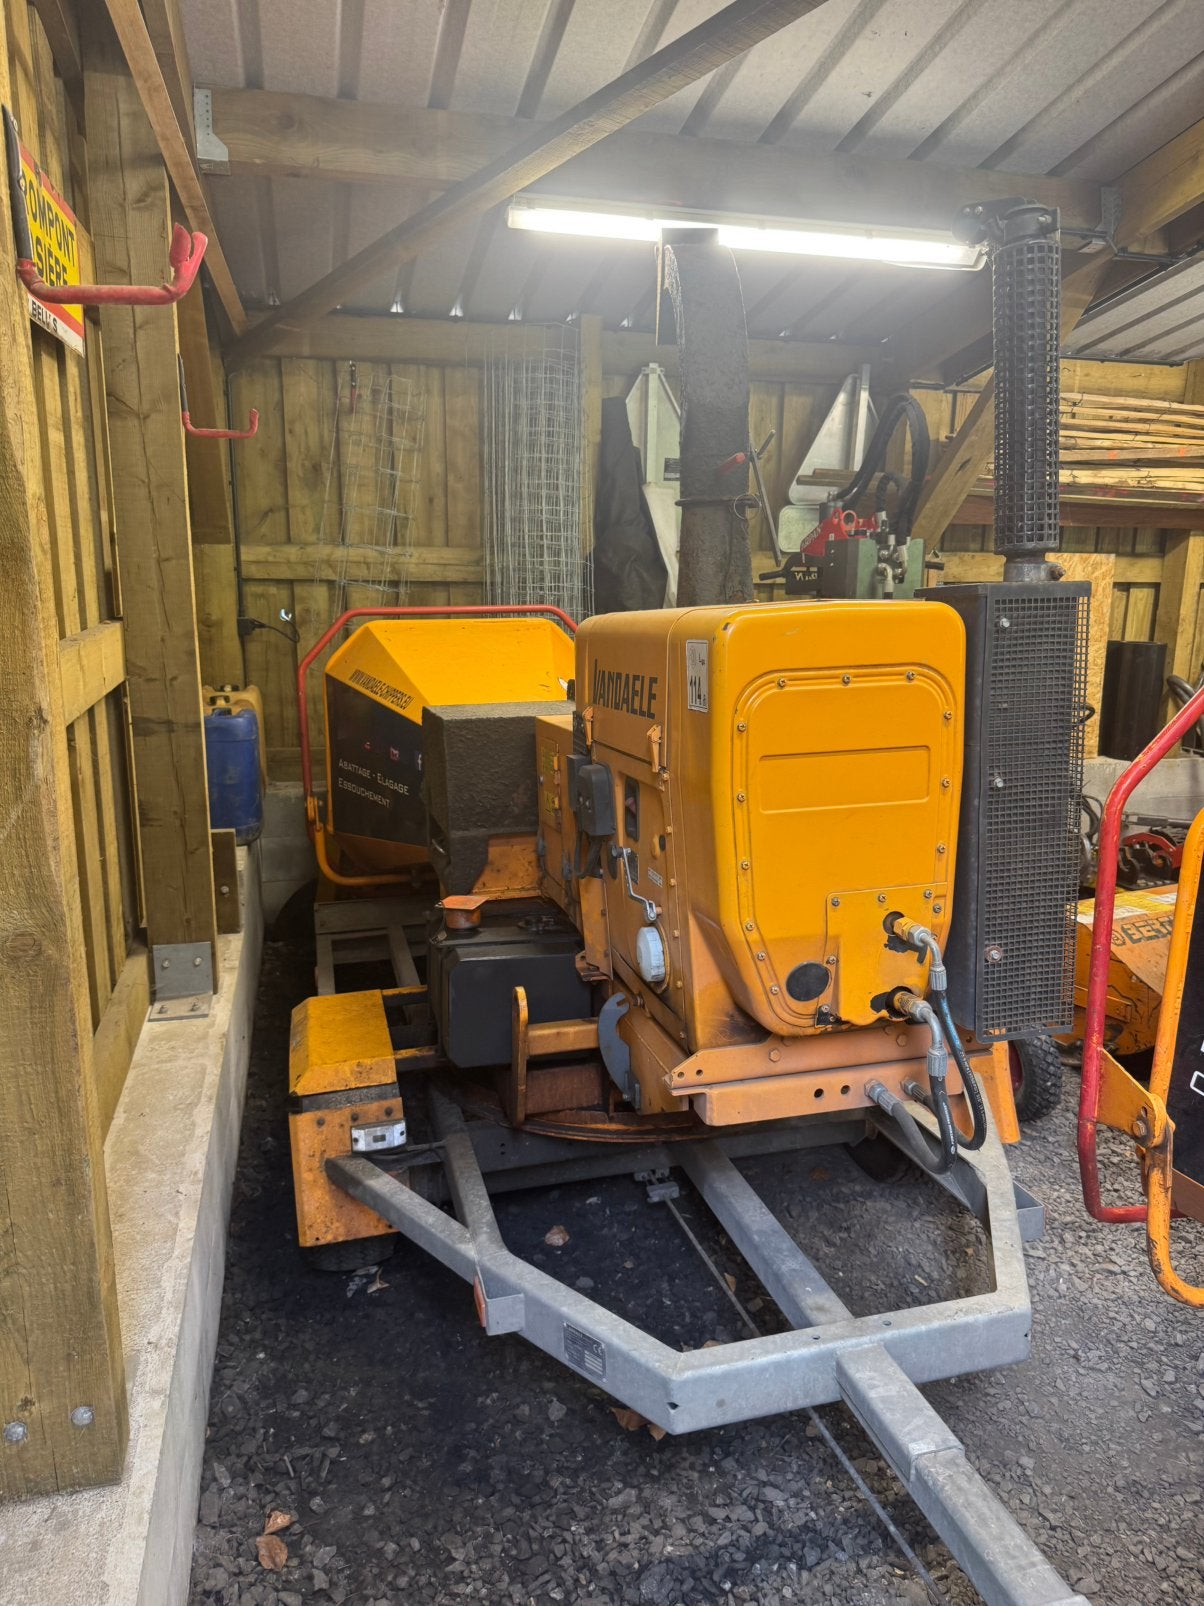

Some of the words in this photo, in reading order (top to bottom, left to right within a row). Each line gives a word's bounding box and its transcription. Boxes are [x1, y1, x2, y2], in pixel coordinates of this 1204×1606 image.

[31, 232, 68, 286] SIÈRE
[592, 658, 658, 720] VANDAELE
[338, 758, 371, 779] ABATTAGE
[338, 778, 391, 808] ESSOUCHEMENT
[1121, 915, 1173, 944] BERT
